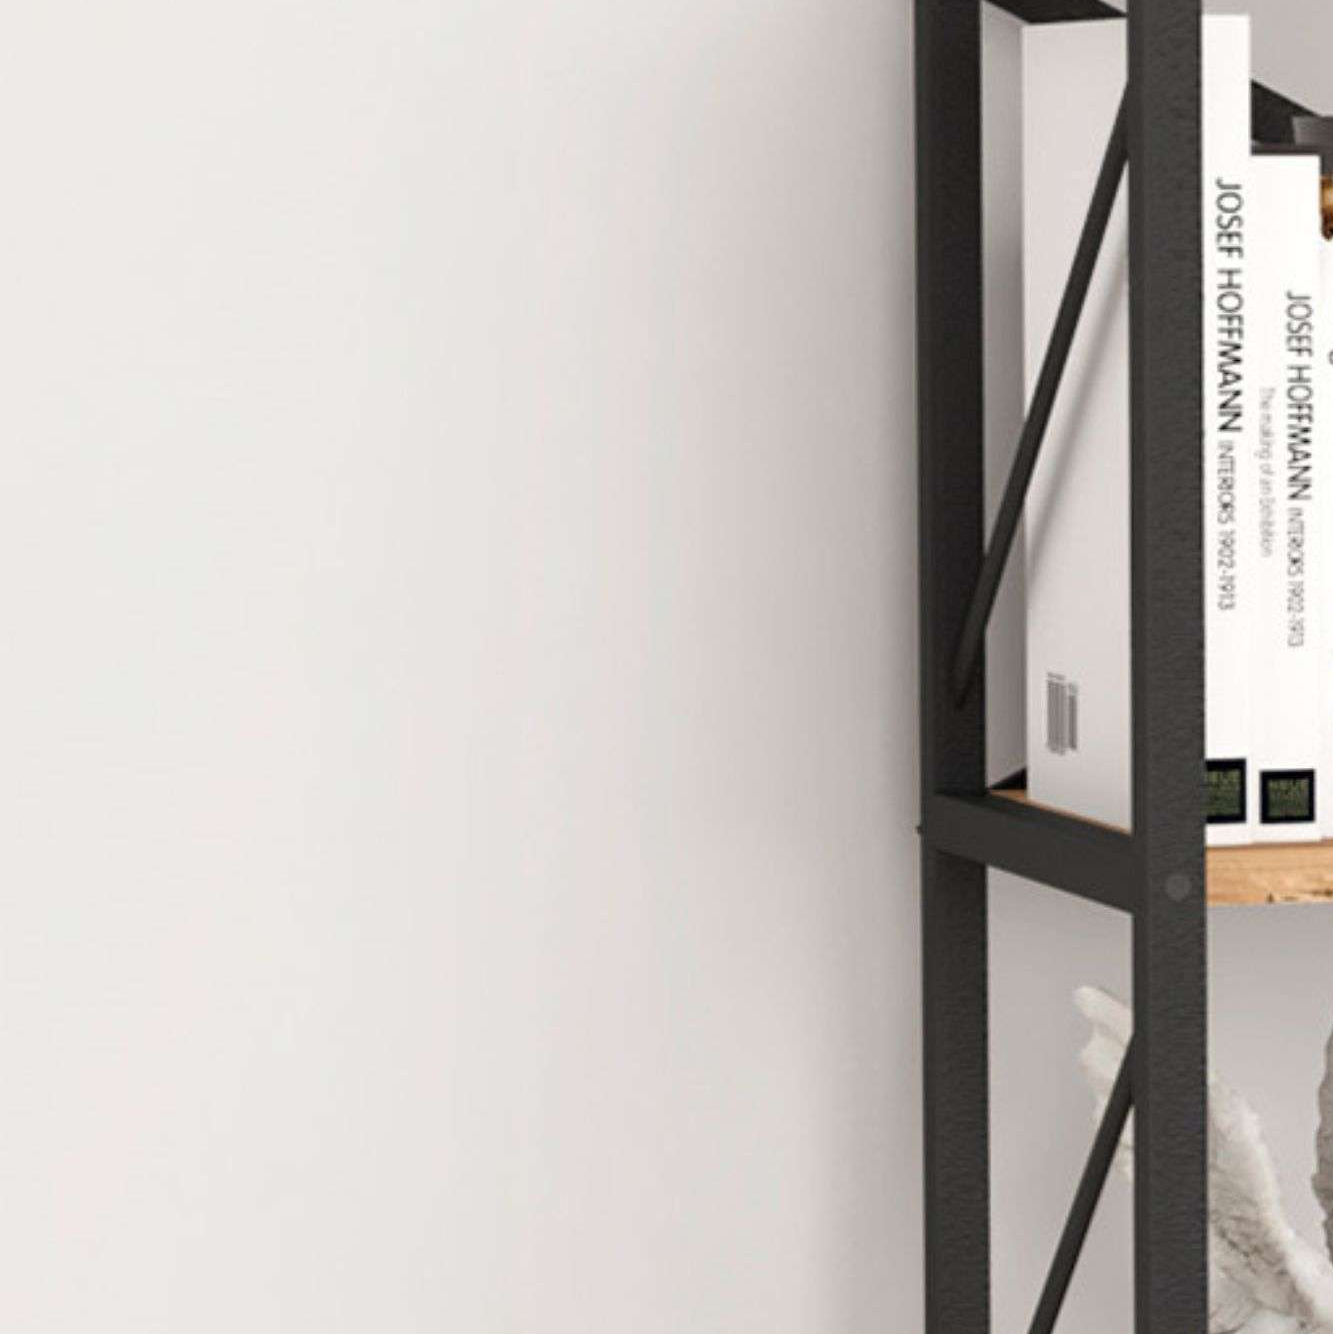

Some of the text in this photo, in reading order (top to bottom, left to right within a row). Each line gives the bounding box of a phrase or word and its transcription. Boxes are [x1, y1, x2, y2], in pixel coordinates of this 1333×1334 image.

[1215, 176, 1244, 259] JOSEF
[1216, 268, 1244, 433] HOFFMANN
[1285, 290, 1314, 357] JOSEF
[1286, 364, 1314, 501] HOFFMANN
[1216, 440, 1236, 524] INTERIORS
